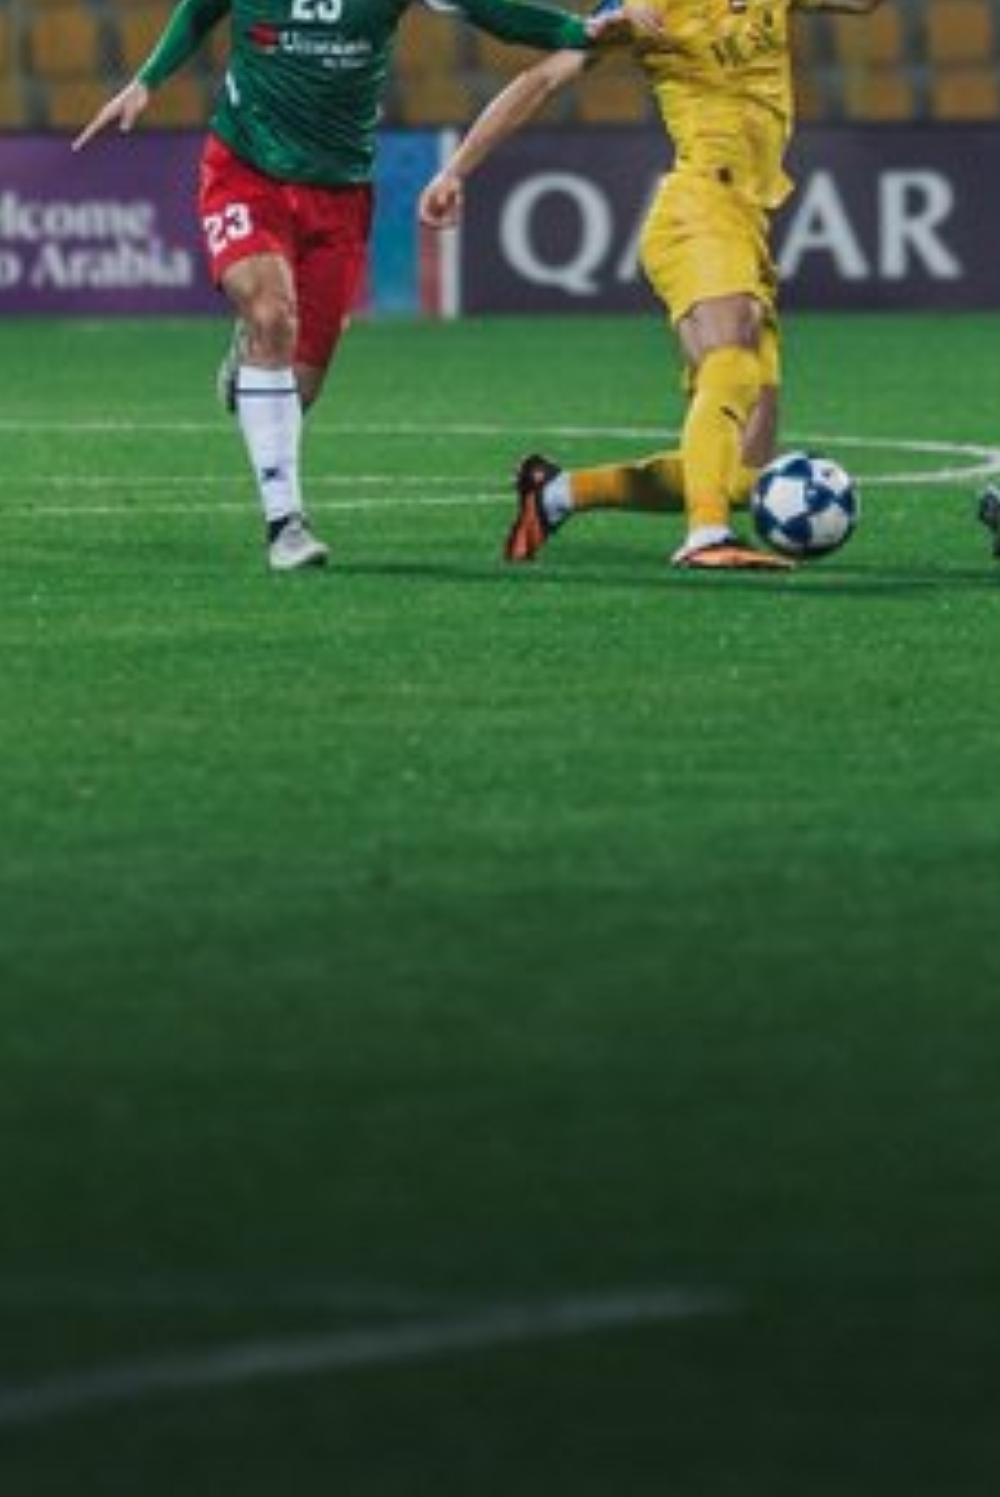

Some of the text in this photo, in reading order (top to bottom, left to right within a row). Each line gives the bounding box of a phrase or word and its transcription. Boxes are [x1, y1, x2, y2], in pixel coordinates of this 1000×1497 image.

[203, 203, 252, 257] 23
[501, 170, 960, 294] QAR
[30, 242, 191, 289] Arabia
